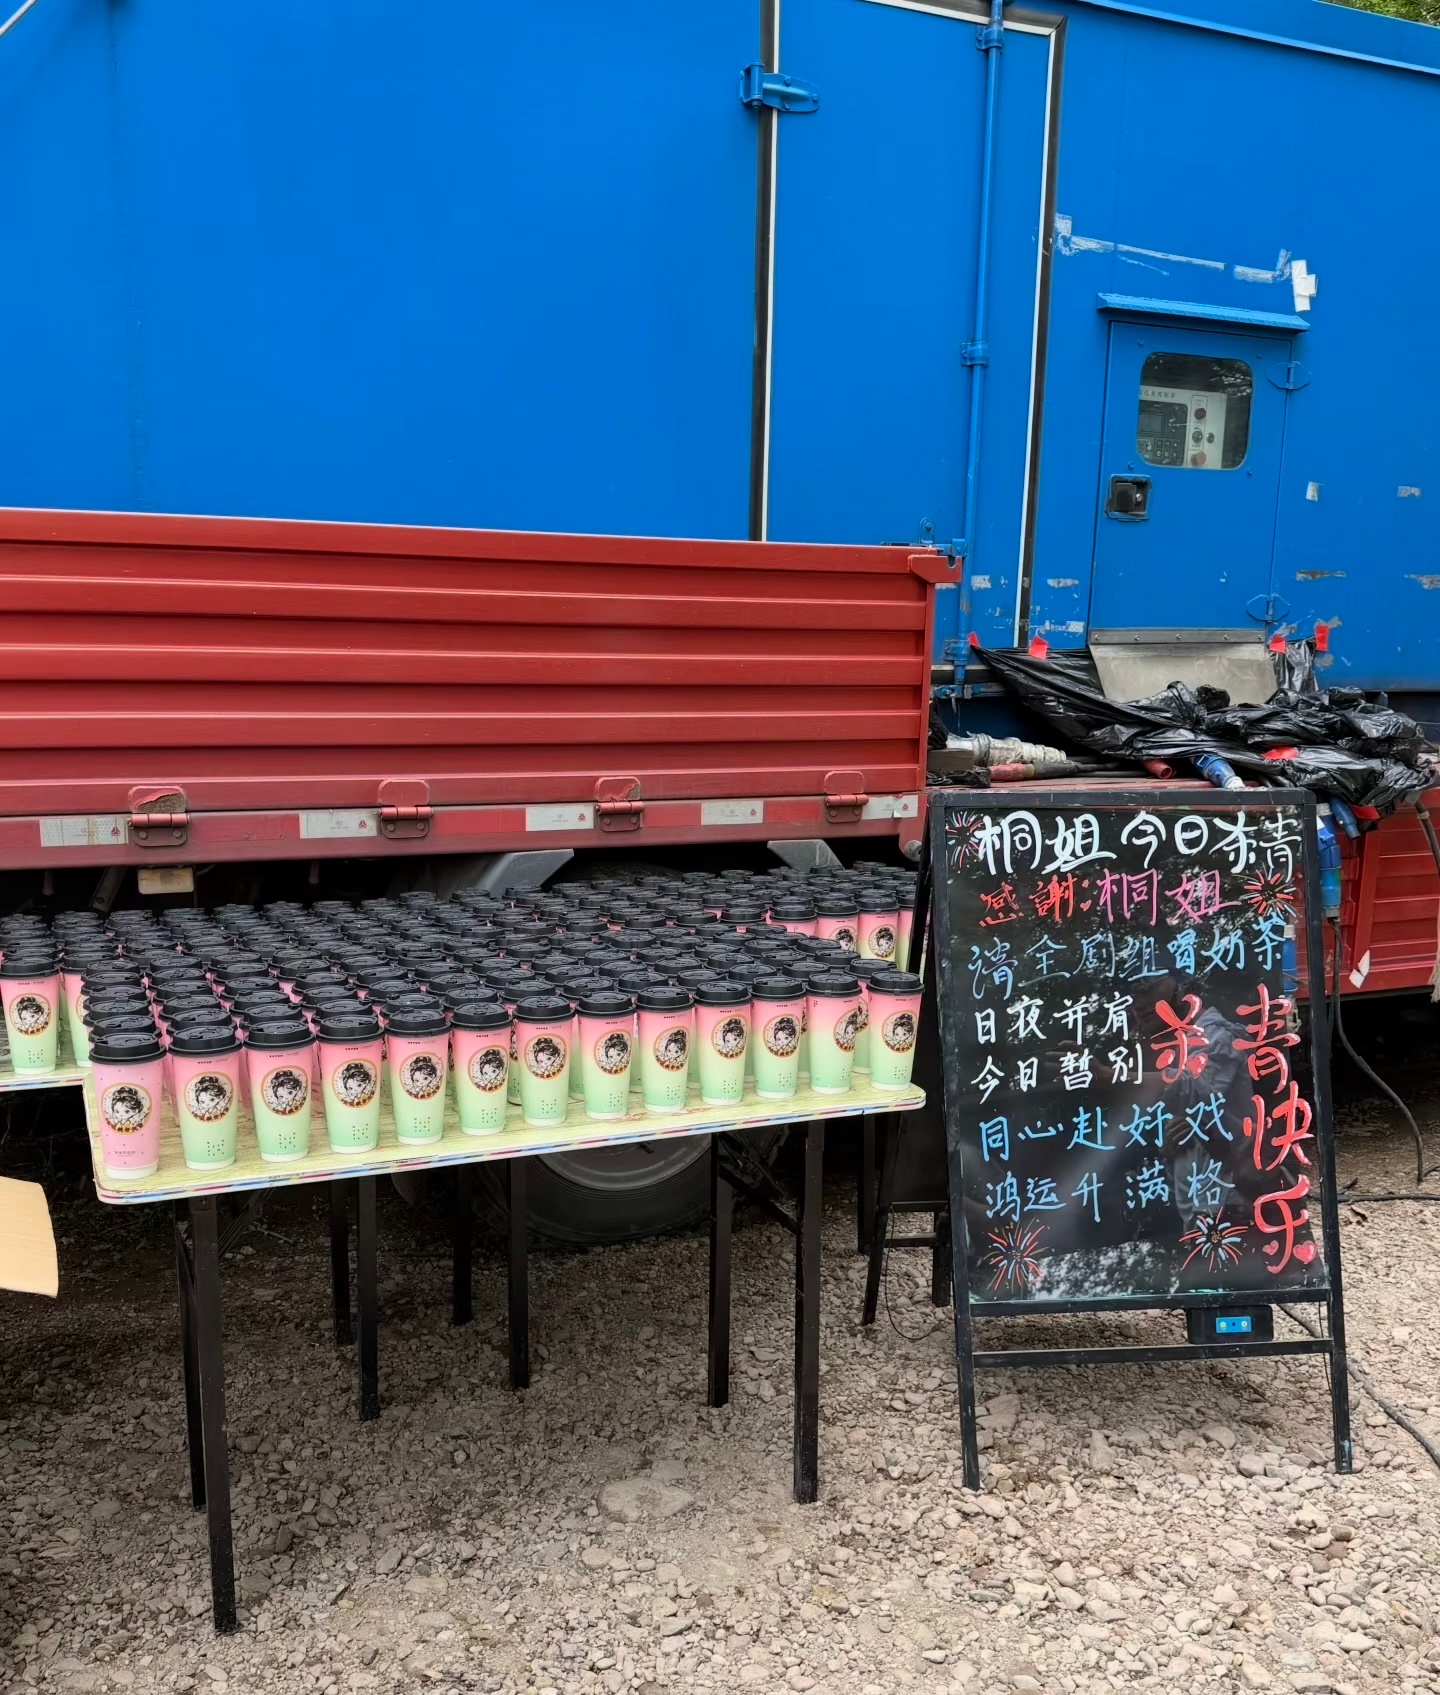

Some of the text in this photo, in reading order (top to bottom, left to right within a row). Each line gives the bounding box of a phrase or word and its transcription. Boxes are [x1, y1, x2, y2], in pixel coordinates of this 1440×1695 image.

[968, 913, 1287, 1000] 请全剧组喝奶茶
[974, 991, 1135, 1045] 日夜并肩
[971, 1043, 1143, 1104] 今日暂别
[979, 1092, 1234, 1162] 同心赴好戏
[986, 1159, 1235, 1222] 鸿运升满格
